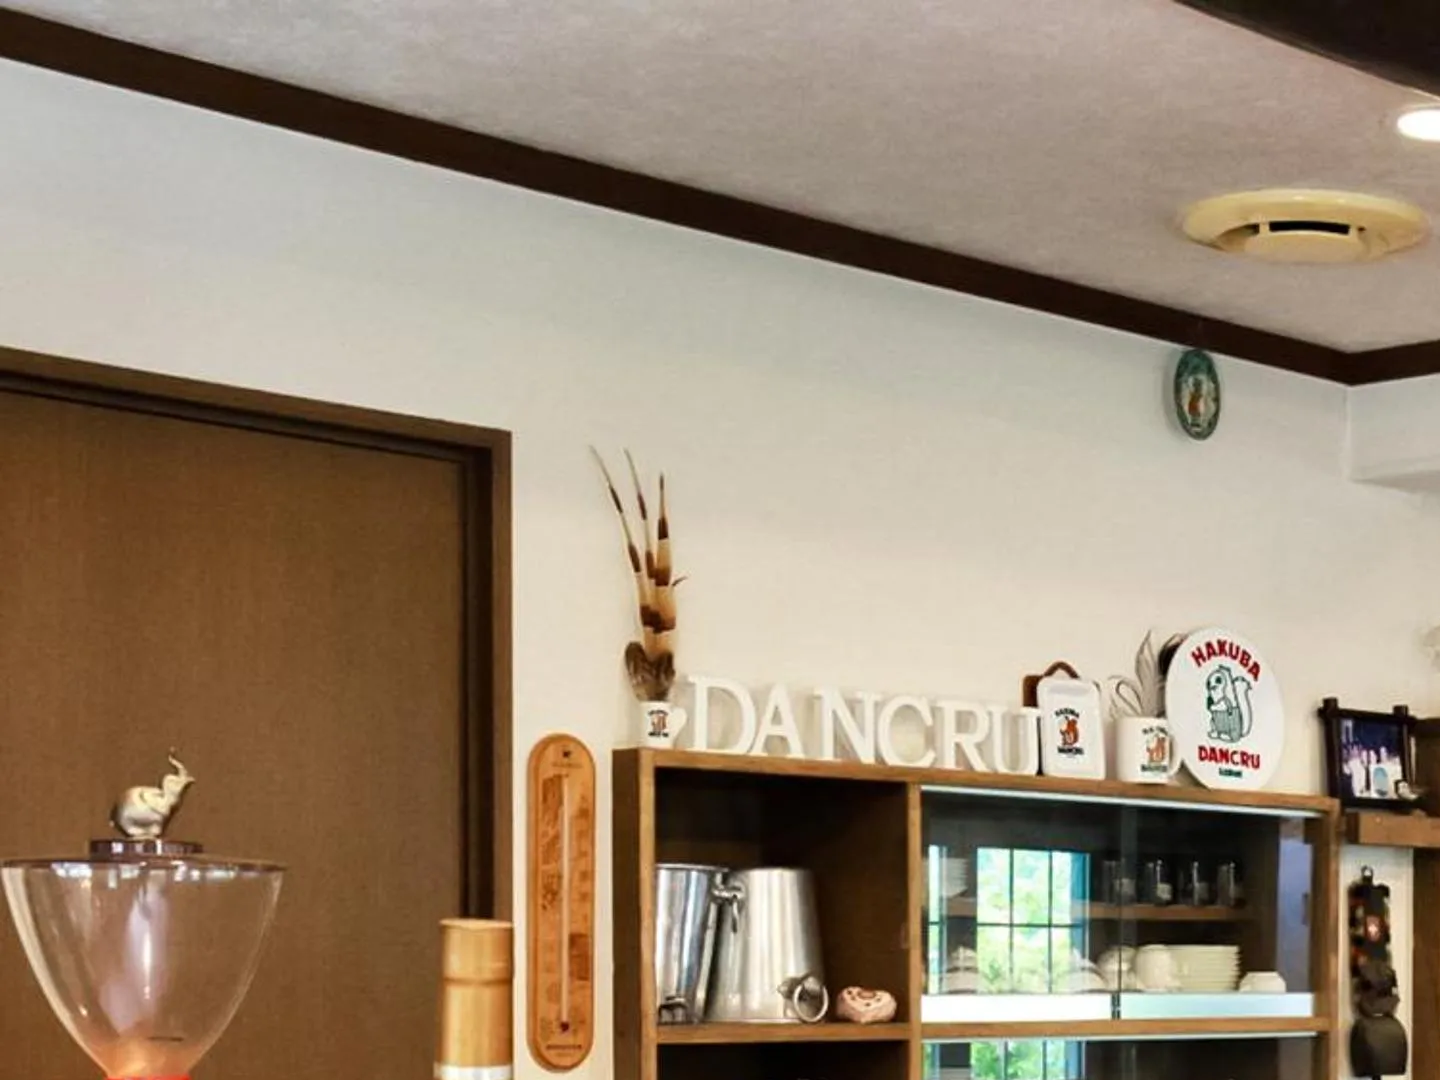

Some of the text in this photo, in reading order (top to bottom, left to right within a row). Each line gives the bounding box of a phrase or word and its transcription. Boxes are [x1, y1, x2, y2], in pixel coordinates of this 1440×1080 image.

[1191, 638, 1261, 682] HAKUBA
[687, 674, 1042, 777] DANCRU
[1197, 744, 1261, 770] DANCRU
